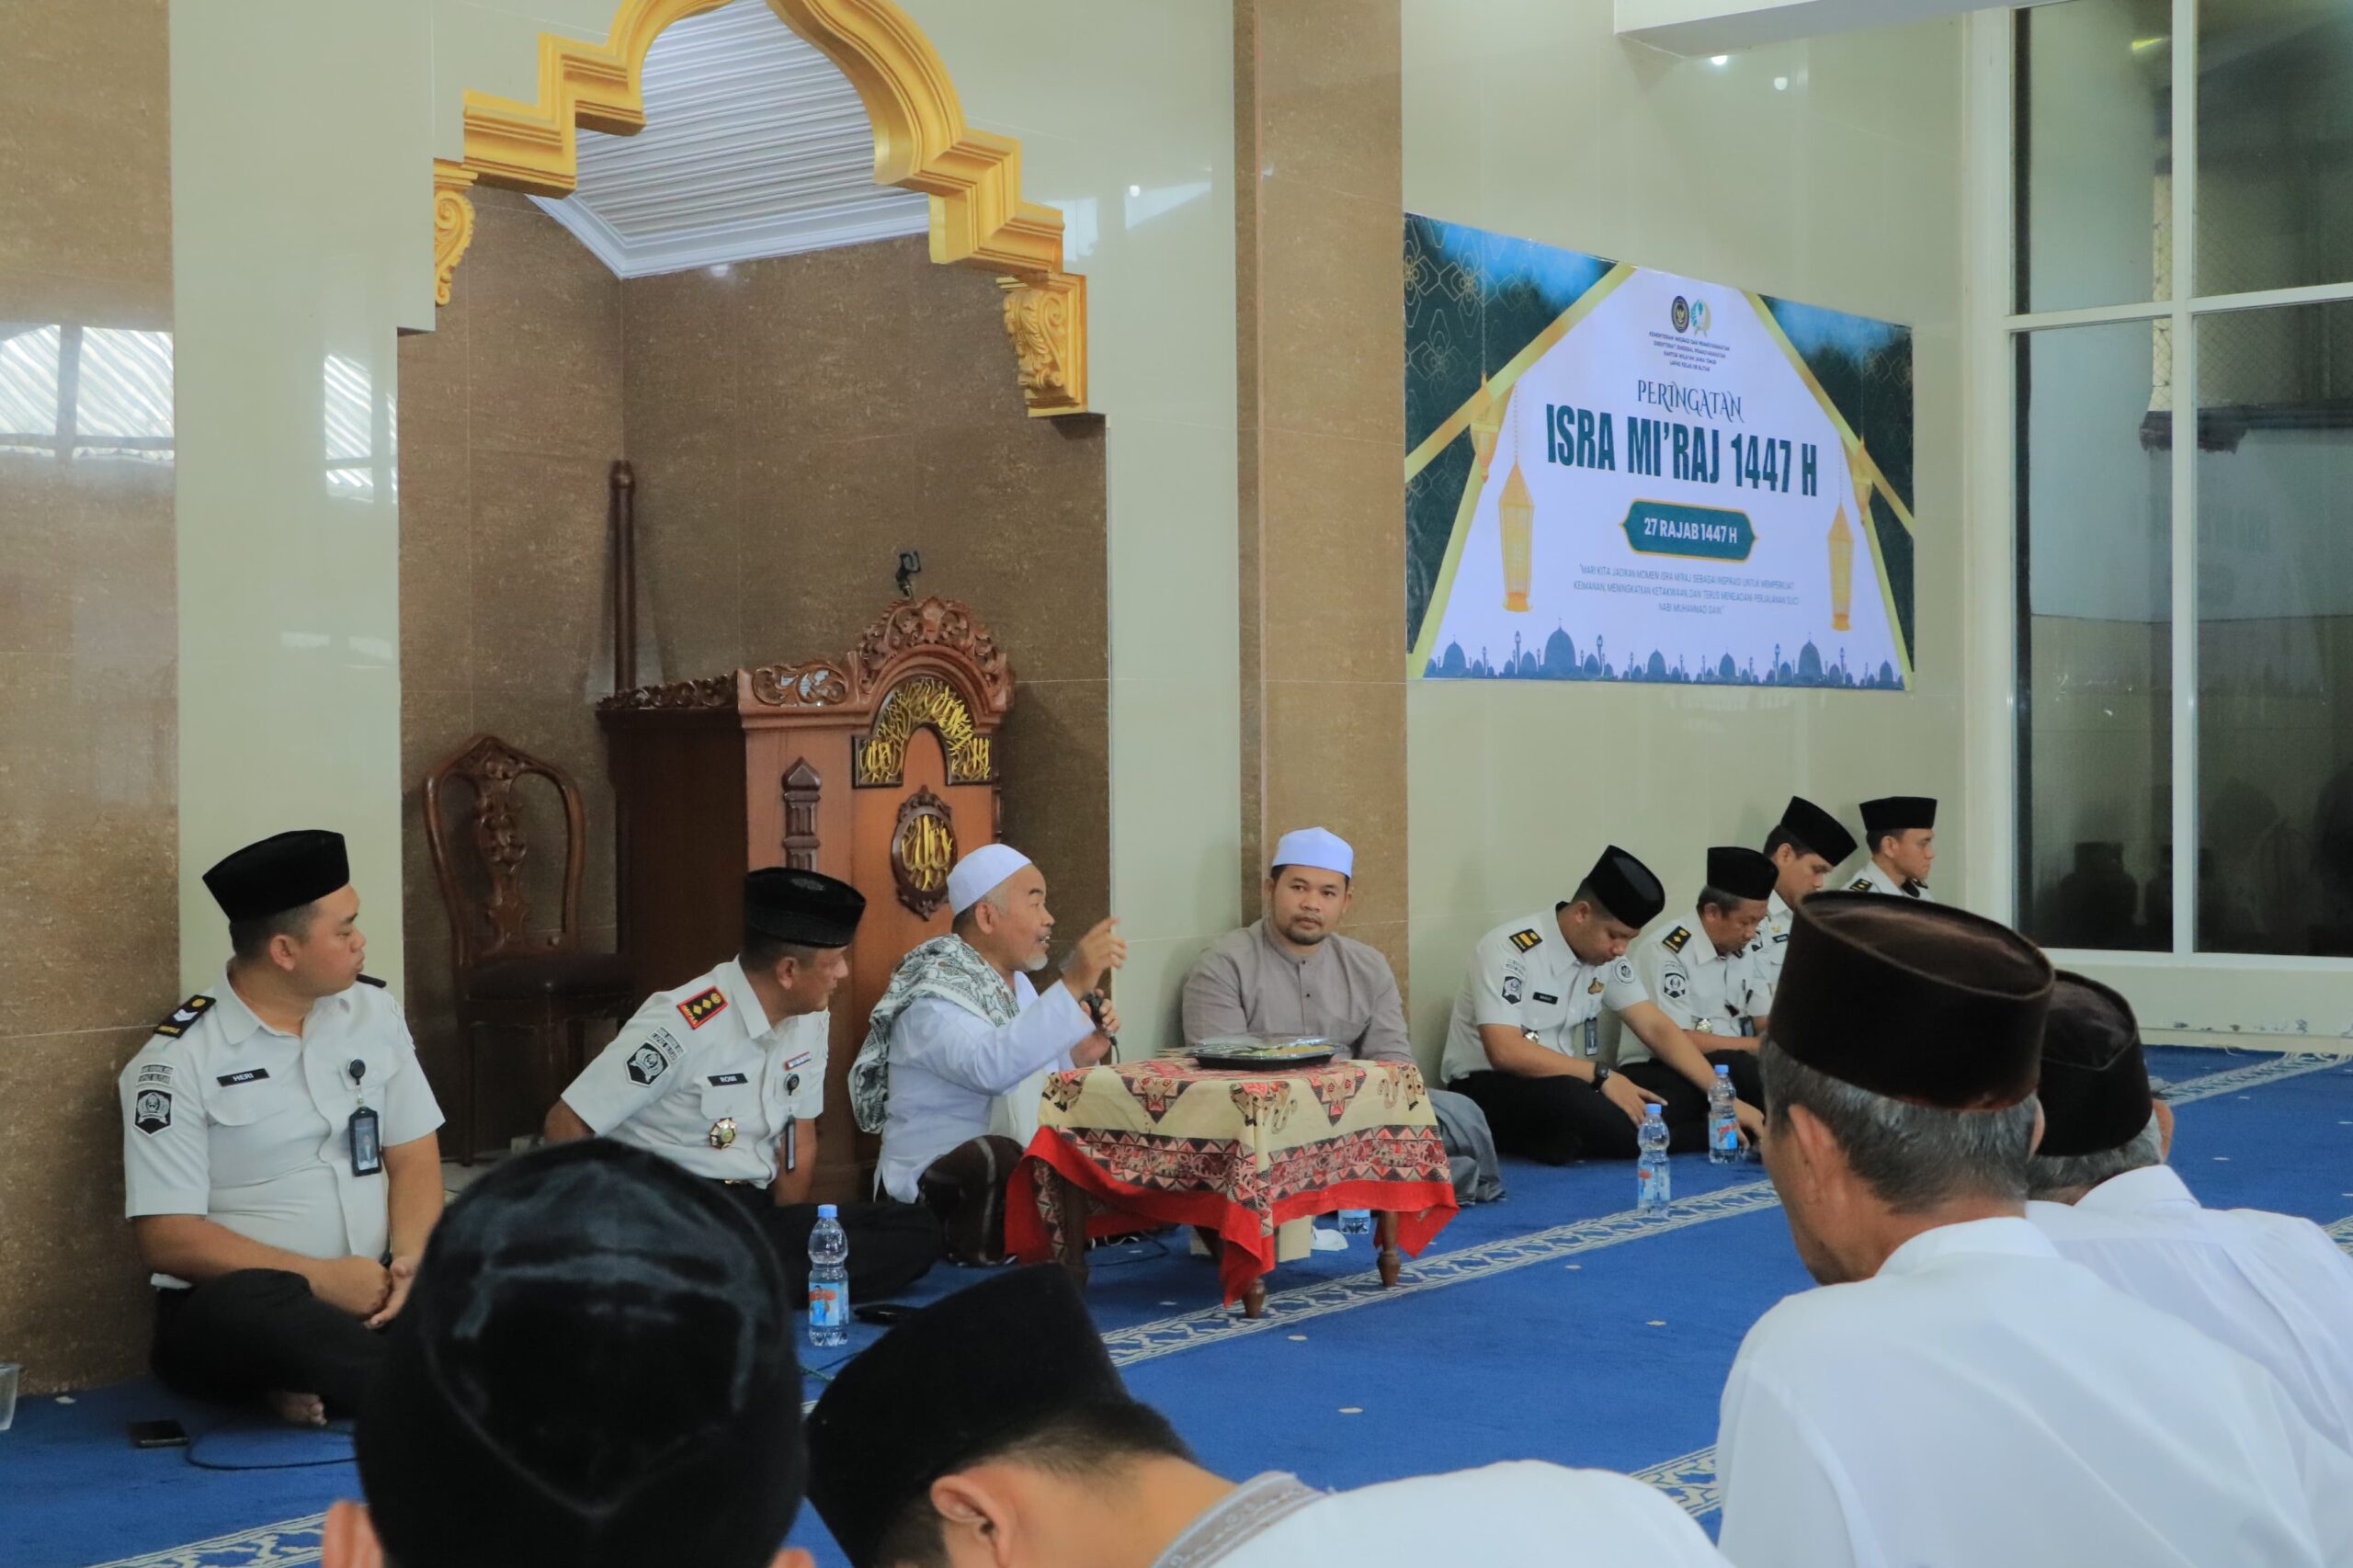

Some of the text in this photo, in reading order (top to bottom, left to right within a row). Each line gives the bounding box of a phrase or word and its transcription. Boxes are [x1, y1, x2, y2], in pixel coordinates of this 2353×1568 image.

[1637, 379, 1745, 423] PERINGATAN
[1546, 403, 1616, 472] ISRA
[1731, 433, 1791, 494] 1447
[1802, 443, 1817, 497] H
[1643, 517, 1737, 544] 27 RAJAB 1447 H
[1597, 566, 1610, 575] KITA
[232, 1073, 255, 1082] HERI
